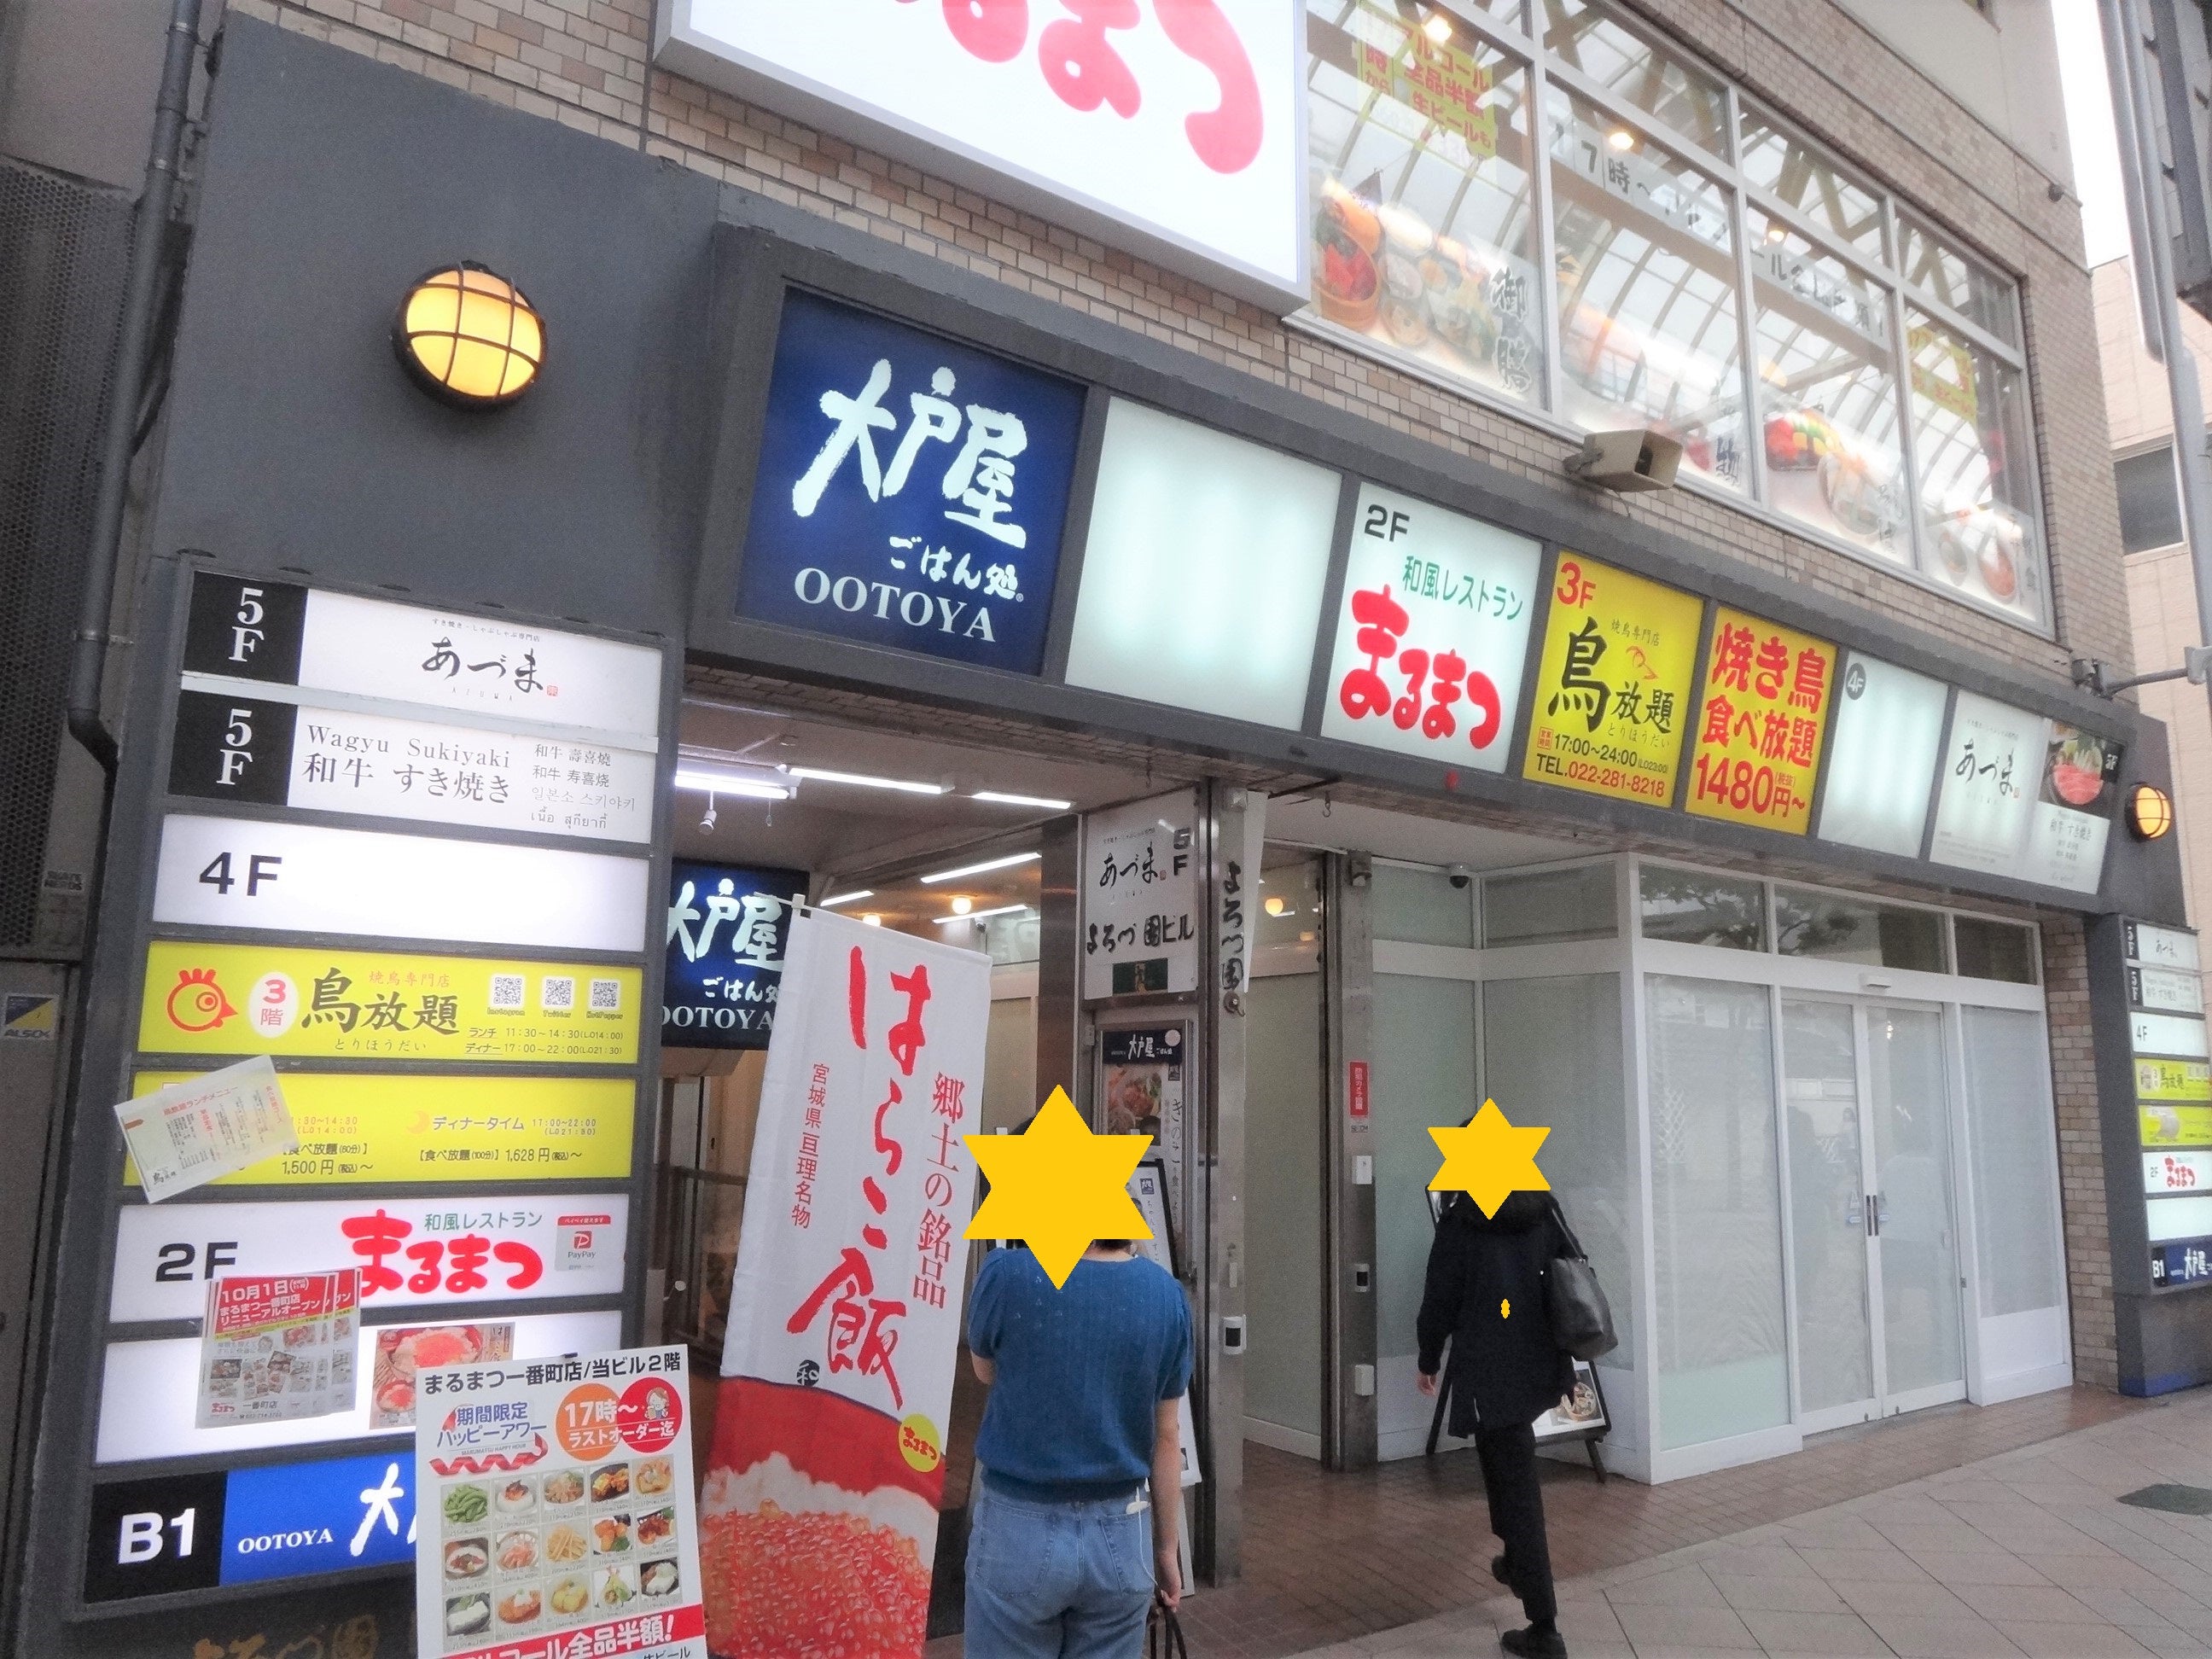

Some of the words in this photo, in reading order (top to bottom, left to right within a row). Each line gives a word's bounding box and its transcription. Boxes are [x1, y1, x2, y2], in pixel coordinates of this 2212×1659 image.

[793, 359, 1027, 549] 大戸屋
[1365, 504, 1411, 543] 2F
[795, 567, 996, 643] OOTOYA
[1402, 555, 1524, 621] 和風レストラン
[1556, 562, 1598, 609] 3F
[421, 637, 544, 694] あづま
[1340, 583, 1502, 750] まるまつ
[1547, 615, 1675, 734] 鳥放題
[1712, 622, 1827, 714] 焼き鳥
[306, 724, 390, 754] Wagyu
[407, 737, 511, 769] Sukiyaki
[534, 743, 562, 760] 和牛
[1703, 693, 1818, 769] 食べ放題
[301, 752, 374, 789] 和牛
[393, 764, 511, 804] すき焼き
[533, 765, 561, 781] 和牛
[1956, 737, 2013, 795] あづま
[199, 852, 283, 897] 4F
[1099, 841, 1158, 888] あづま
[300, 967, 461, 1036] 鳥放題
[432, 1116, 525, 1131] ディナータイム
[790, 1062, 830, 1230] 宮城県亘理名物
[786, 945, 932, 1412] はらこ飯
[912, 1070, 966, 1309] 郷土の銘品
[423, 1211, 544, 1231] 和風レストラン
[155, 1242, 238, 1282] 2F
[341, 1208, 544, 1297] まるまつ
[568, 1250, 597, 1260] PayPay
[436, 1422, 547, 1448] ハッピーアワー
[457, 1401, 528, 1426] 期間限定
[118, 1508, 195, 1565] B1
[237, 1528, 334, 1555] OOTOYA
